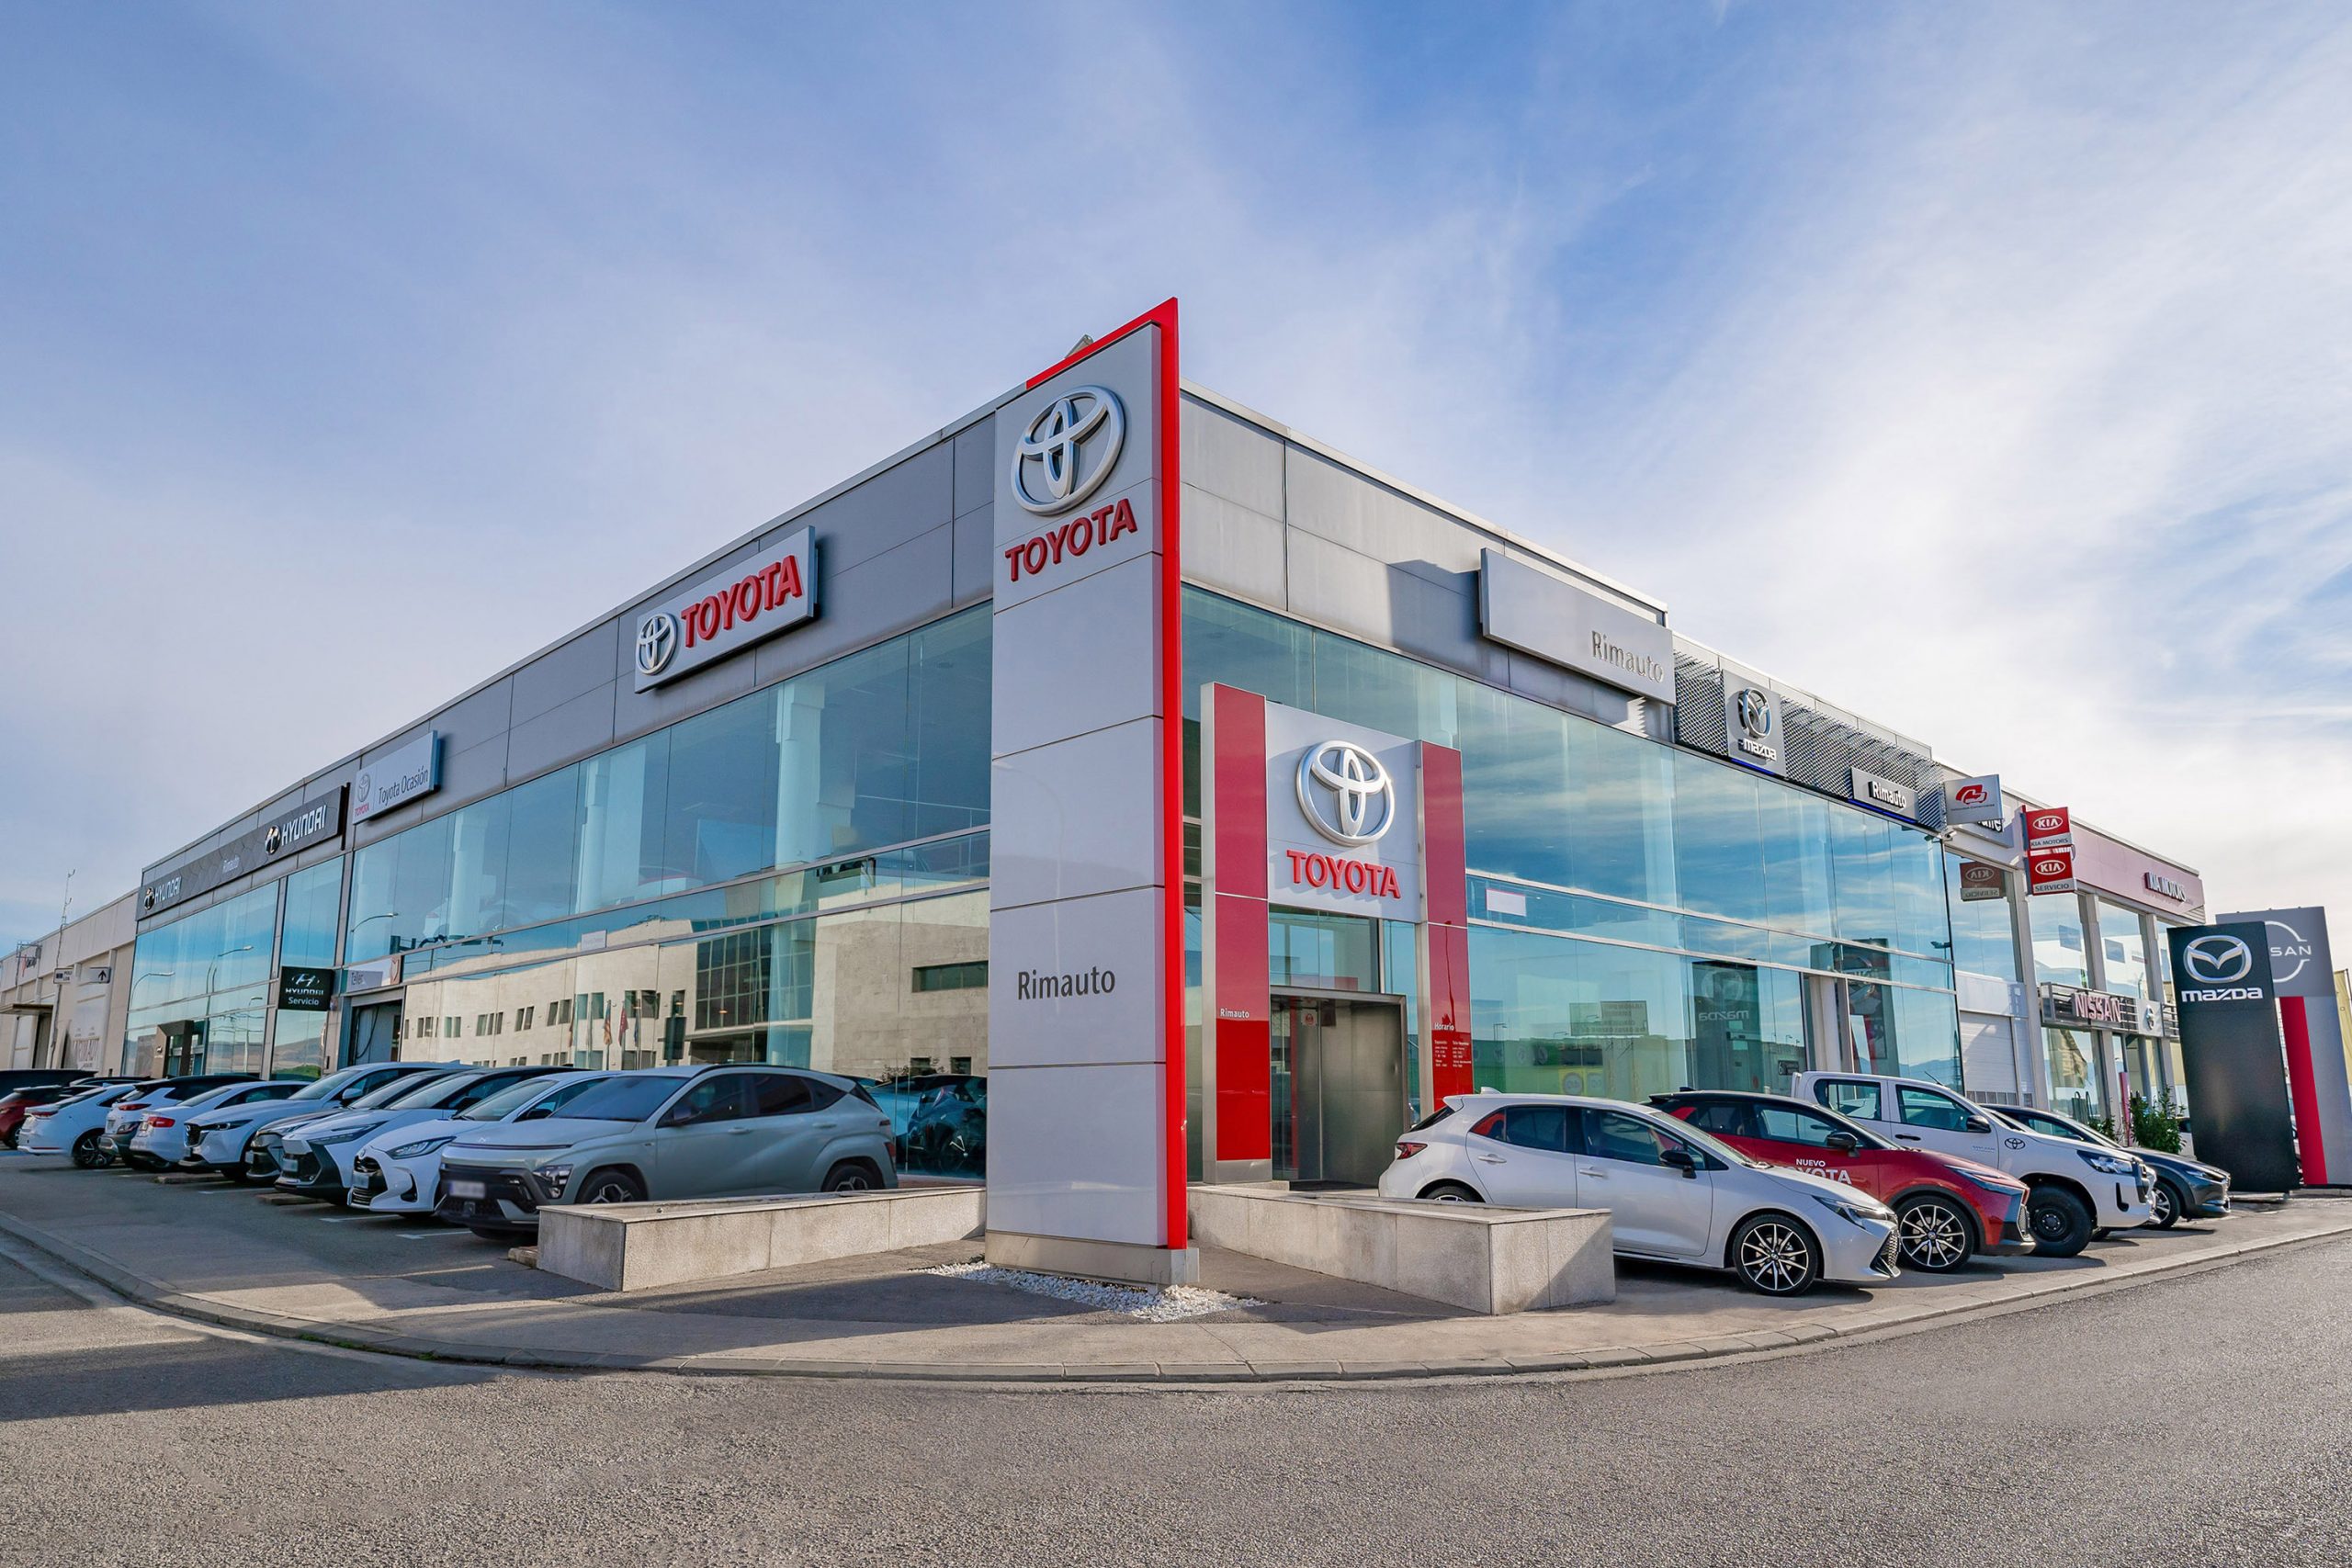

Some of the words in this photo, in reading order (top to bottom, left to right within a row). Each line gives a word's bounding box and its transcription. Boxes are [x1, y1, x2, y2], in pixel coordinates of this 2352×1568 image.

[1004, 498, 1138, 582] TOYOTA
[681, 554, 803, 649] TOYOTA
[1590, 629, 1665, 683] Rimauto
[1739, 738, 1777, 761] mazda
[379, 782, 401, 807] Toyota
[401, 765, 429, 795] Ocasión
[1870, 781, 1907, 809] Rimauto
[281, 805, 327, 846] HYUNDAI
[2037, 818, 2059, 829] KIA
[1286, 849, 1402, 899] TOYOTA
[2040, 862, 2062, 873] KIA
[154, 876, 182, 905] HYUNDAI
[2034, 883, 2070, 892] SERVICIO
[2269, 945, 2312, 957] SAN
[1017, 965, 1116, 1001] Rimauto
[2181, 987, 2264, 1002] mazda
[288, 997, 320, 1006] Servicio
[1220, 1009, 1250, 1019] Rimauto
[2074, 992, 2122, 1023] NISSAN
[1434, 1022, 1455, 1031] Horario
[1795, 1158, 1826, 1168] NUEVO
